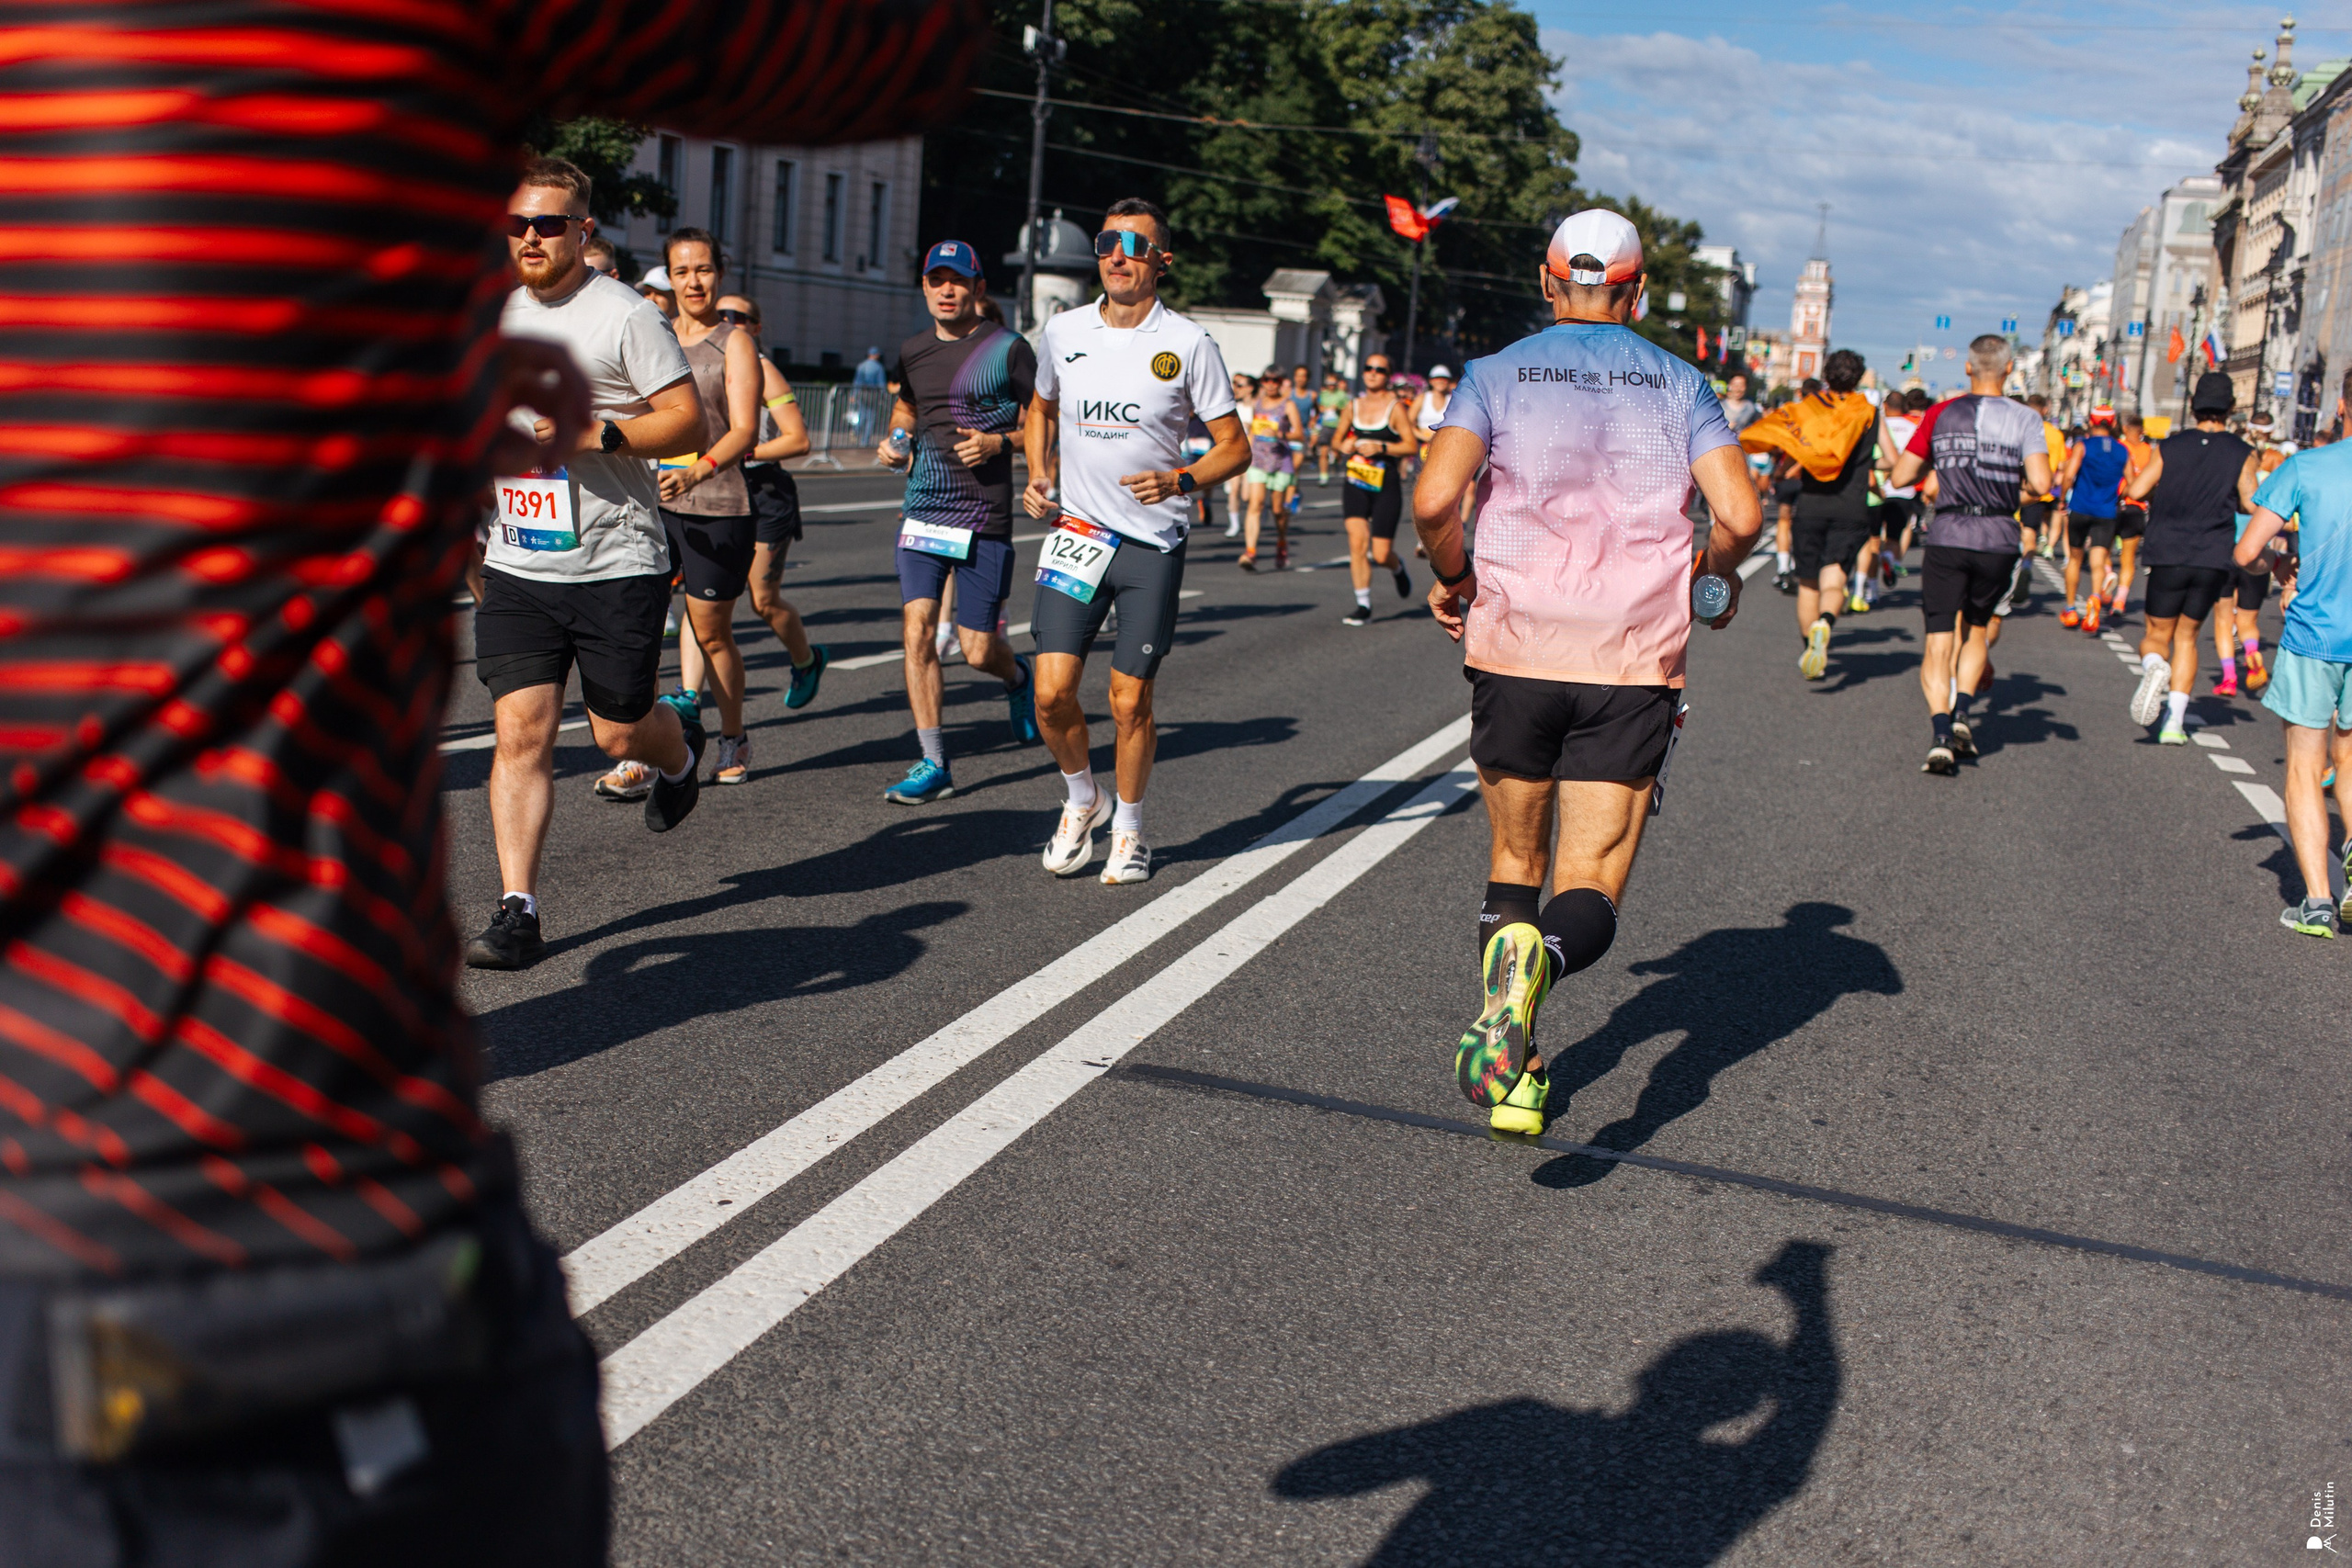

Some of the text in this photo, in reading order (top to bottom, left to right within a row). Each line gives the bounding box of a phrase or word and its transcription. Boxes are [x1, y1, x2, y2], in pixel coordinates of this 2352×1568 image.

[1518, 367, 1667, 389] БЕЛЫЕ НОЧИ
[1574, 384, 1613, 395] МАРАФОН
[1083, 400, 1141, 423] ИКС
[1084, 430, 1130, 440] ХОЛДИНГ
[503, 488, 557, 519] 7391
[508, 528, 516, 542] D
[904, 536, 916, 547] D
[1050, 535, 1103, 568] 1247
[1051, 558, 1079, 571] КИРИЛЛ
